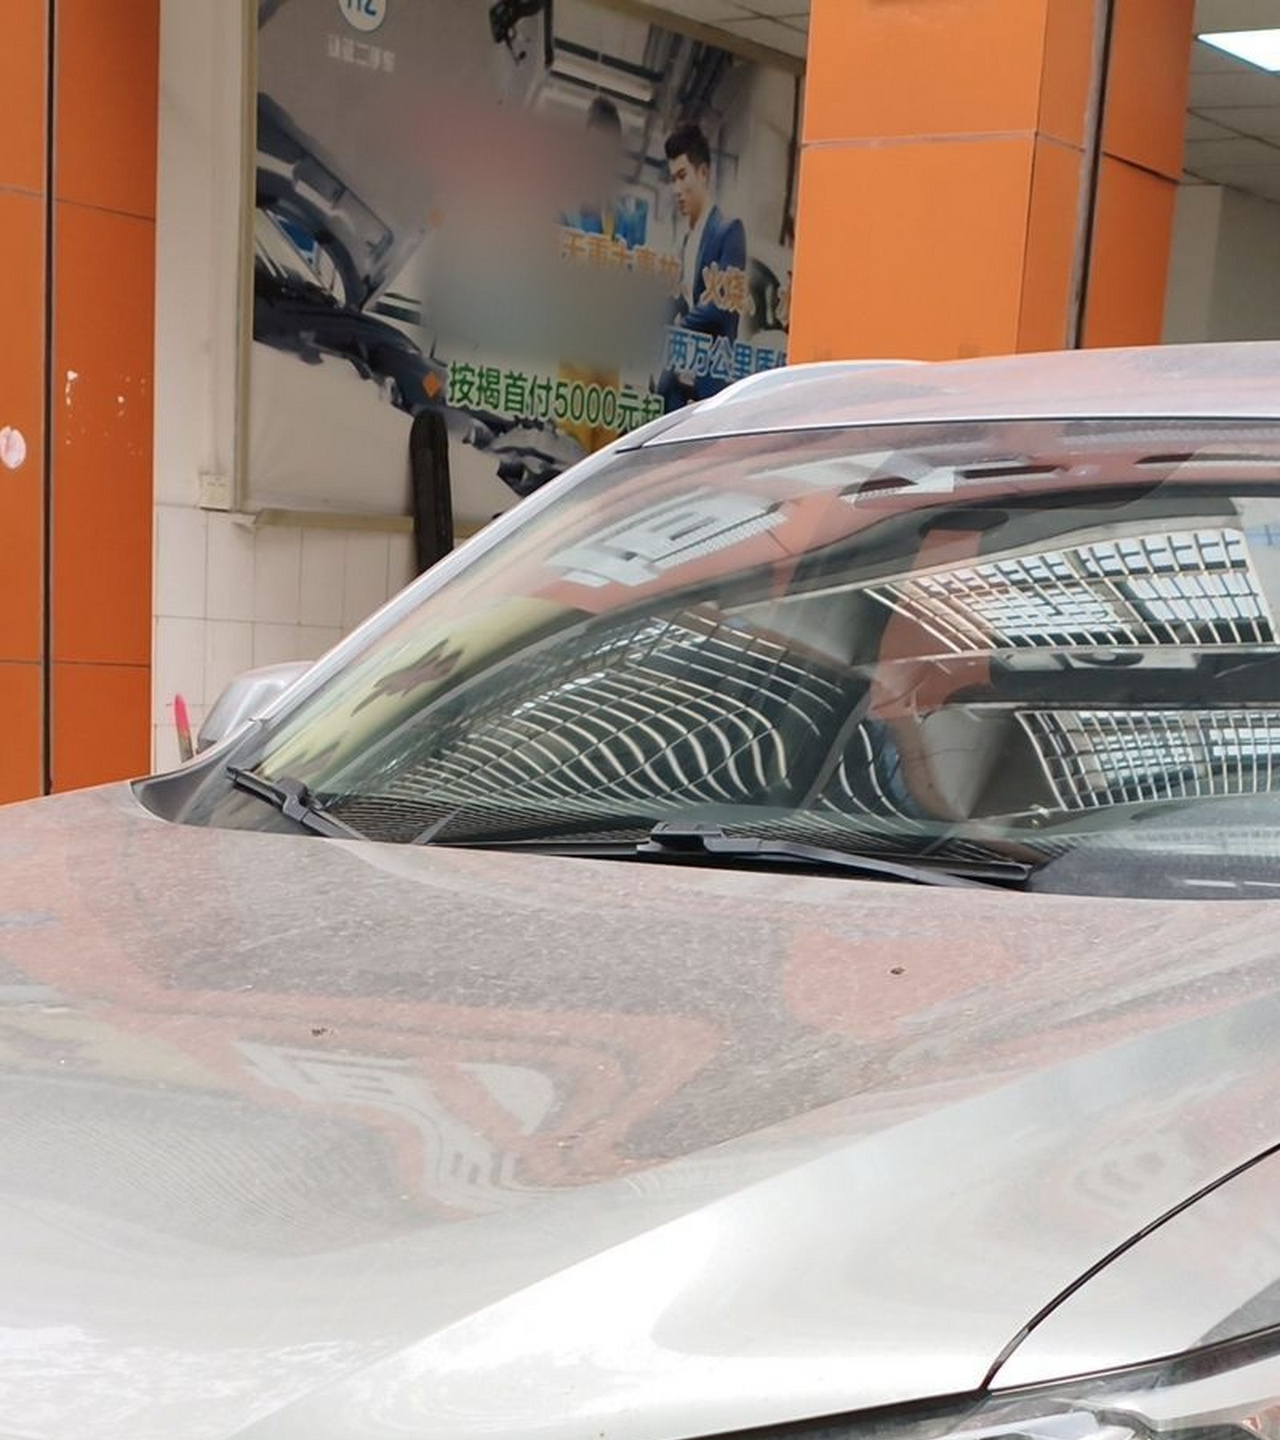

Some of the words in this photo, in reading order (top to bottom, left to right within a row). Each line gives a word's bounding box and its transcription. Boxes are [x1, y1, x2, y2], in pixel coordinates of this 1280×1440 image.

[449, 361, 665, 430] 按揭首付5000元起
